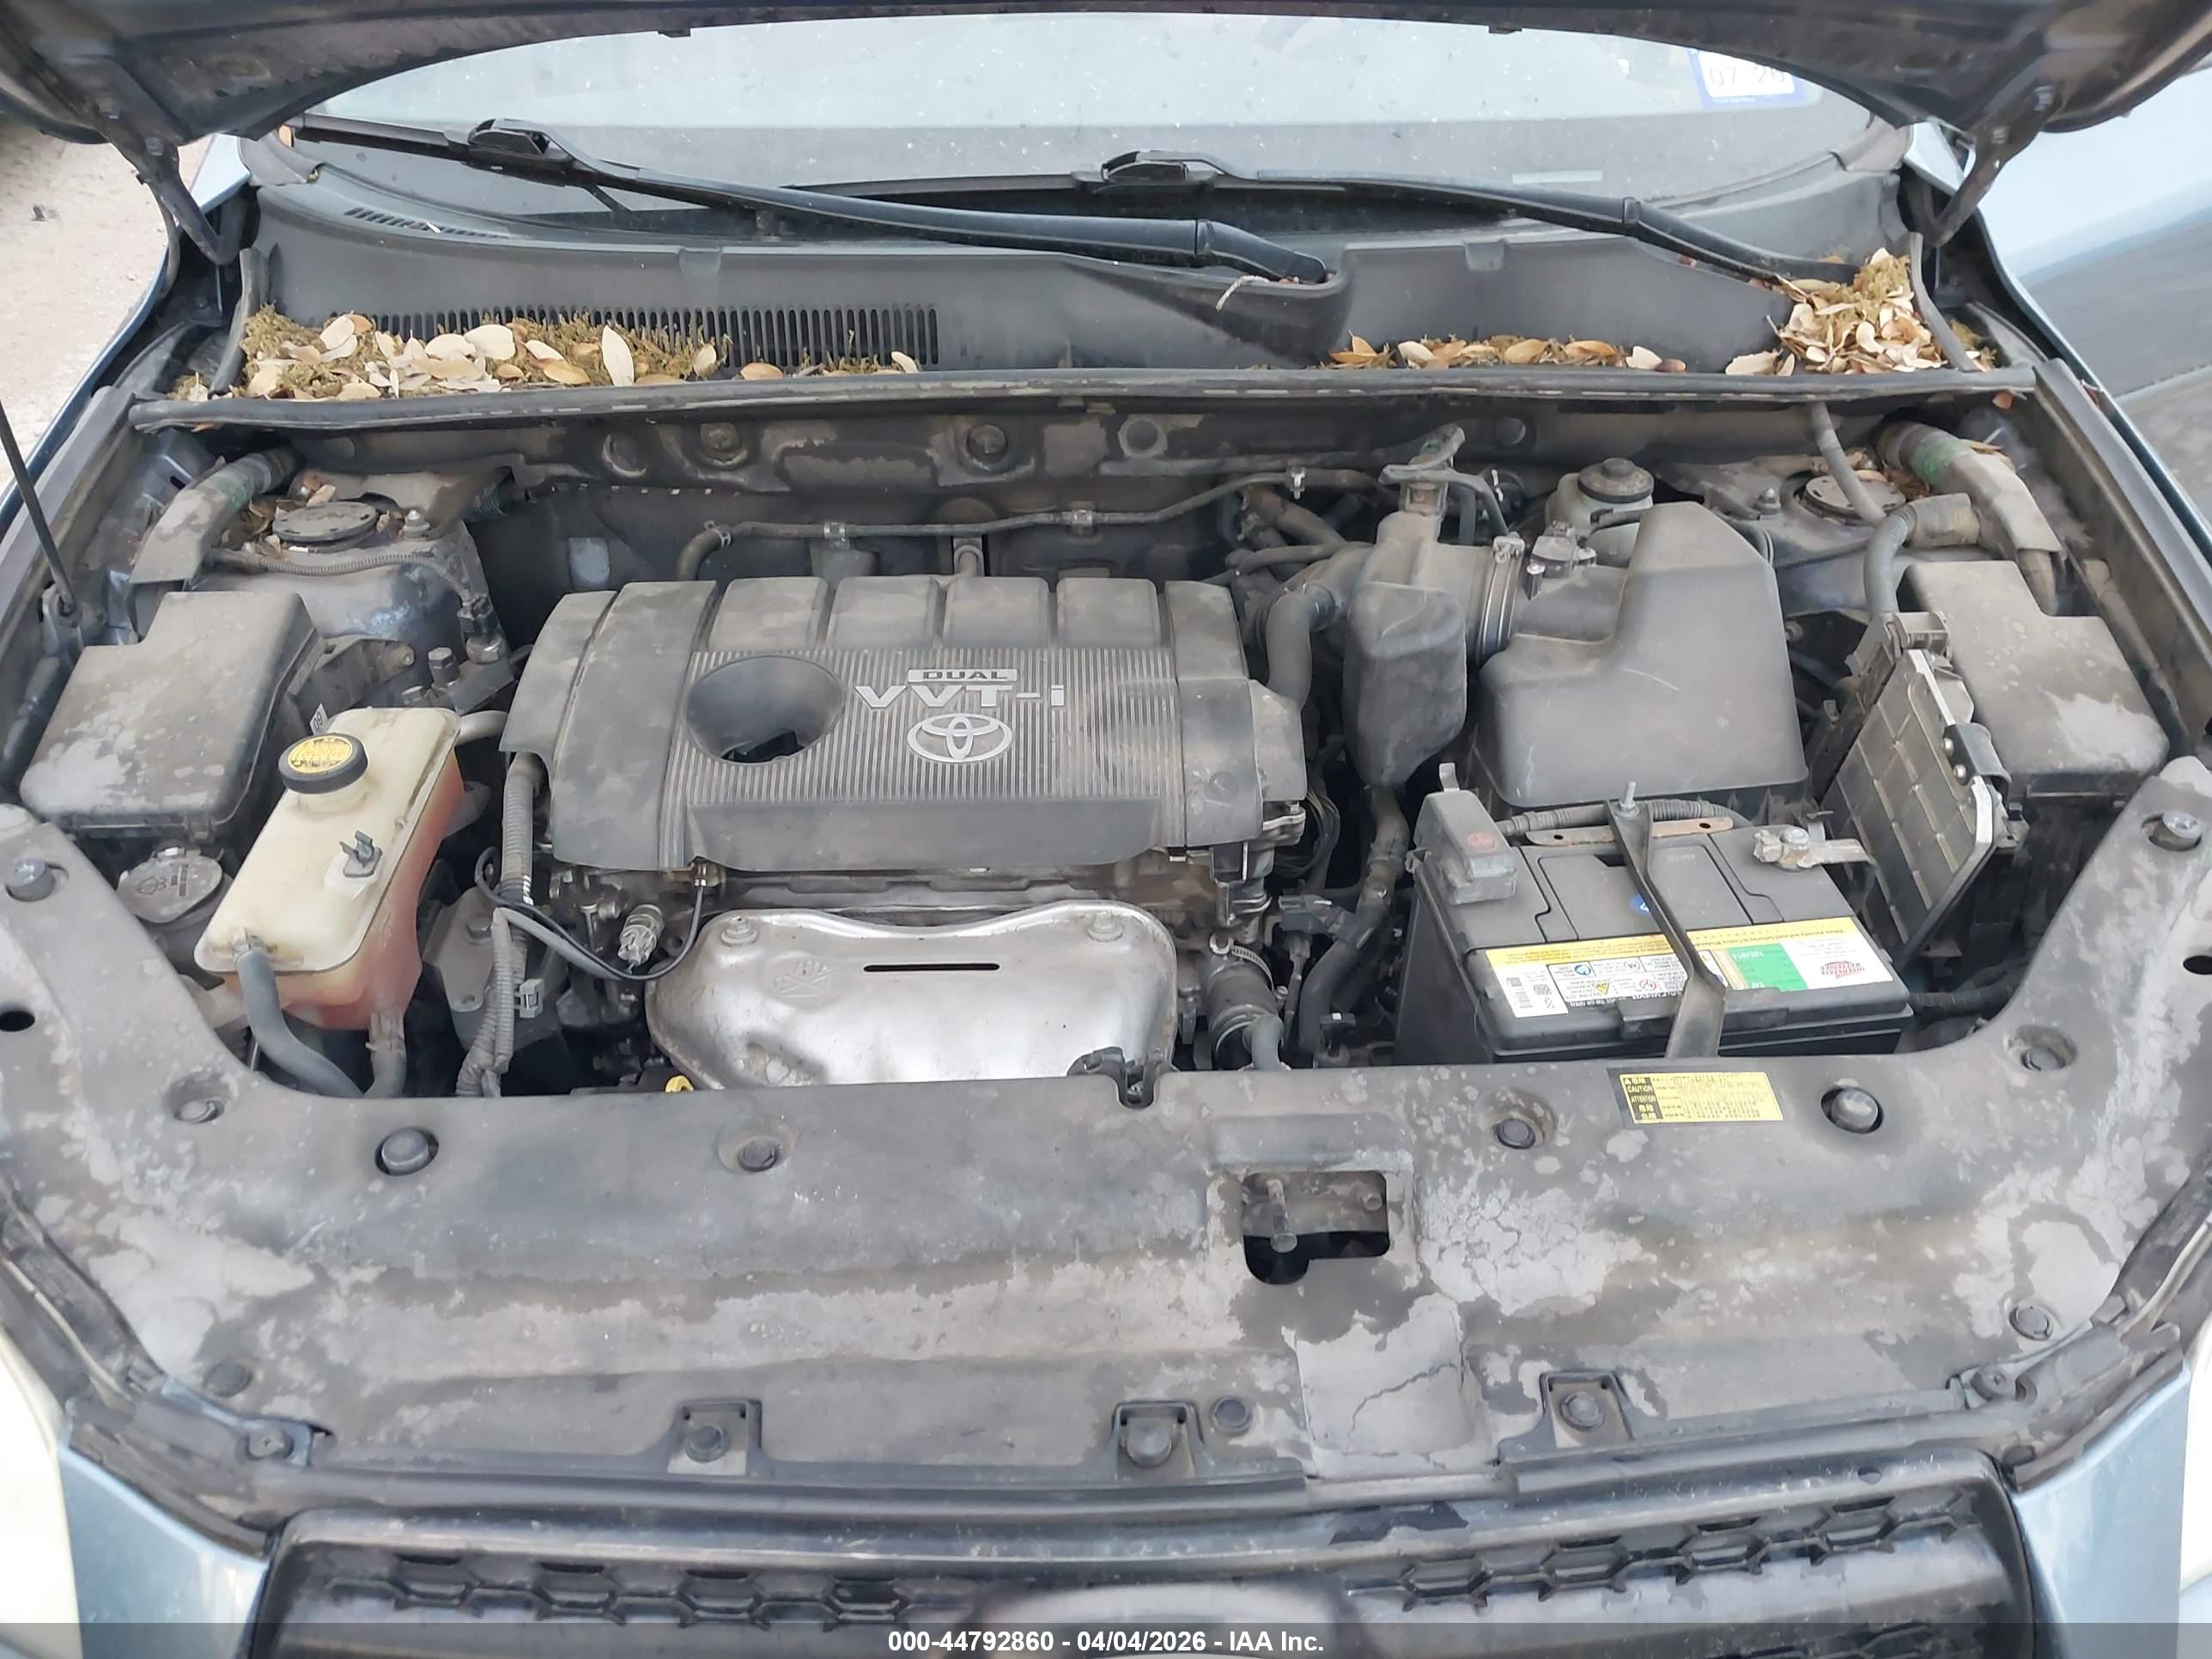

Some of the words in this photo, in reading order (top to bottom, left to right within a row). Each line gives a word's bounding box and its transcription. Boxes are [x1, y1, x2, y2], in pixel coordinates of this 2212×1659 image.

[922, 670, 1009, 681] DUAL
[854, 684, 1066, 708] VVT-i
[1627, 1084, 1654, 1093] CAUTION
